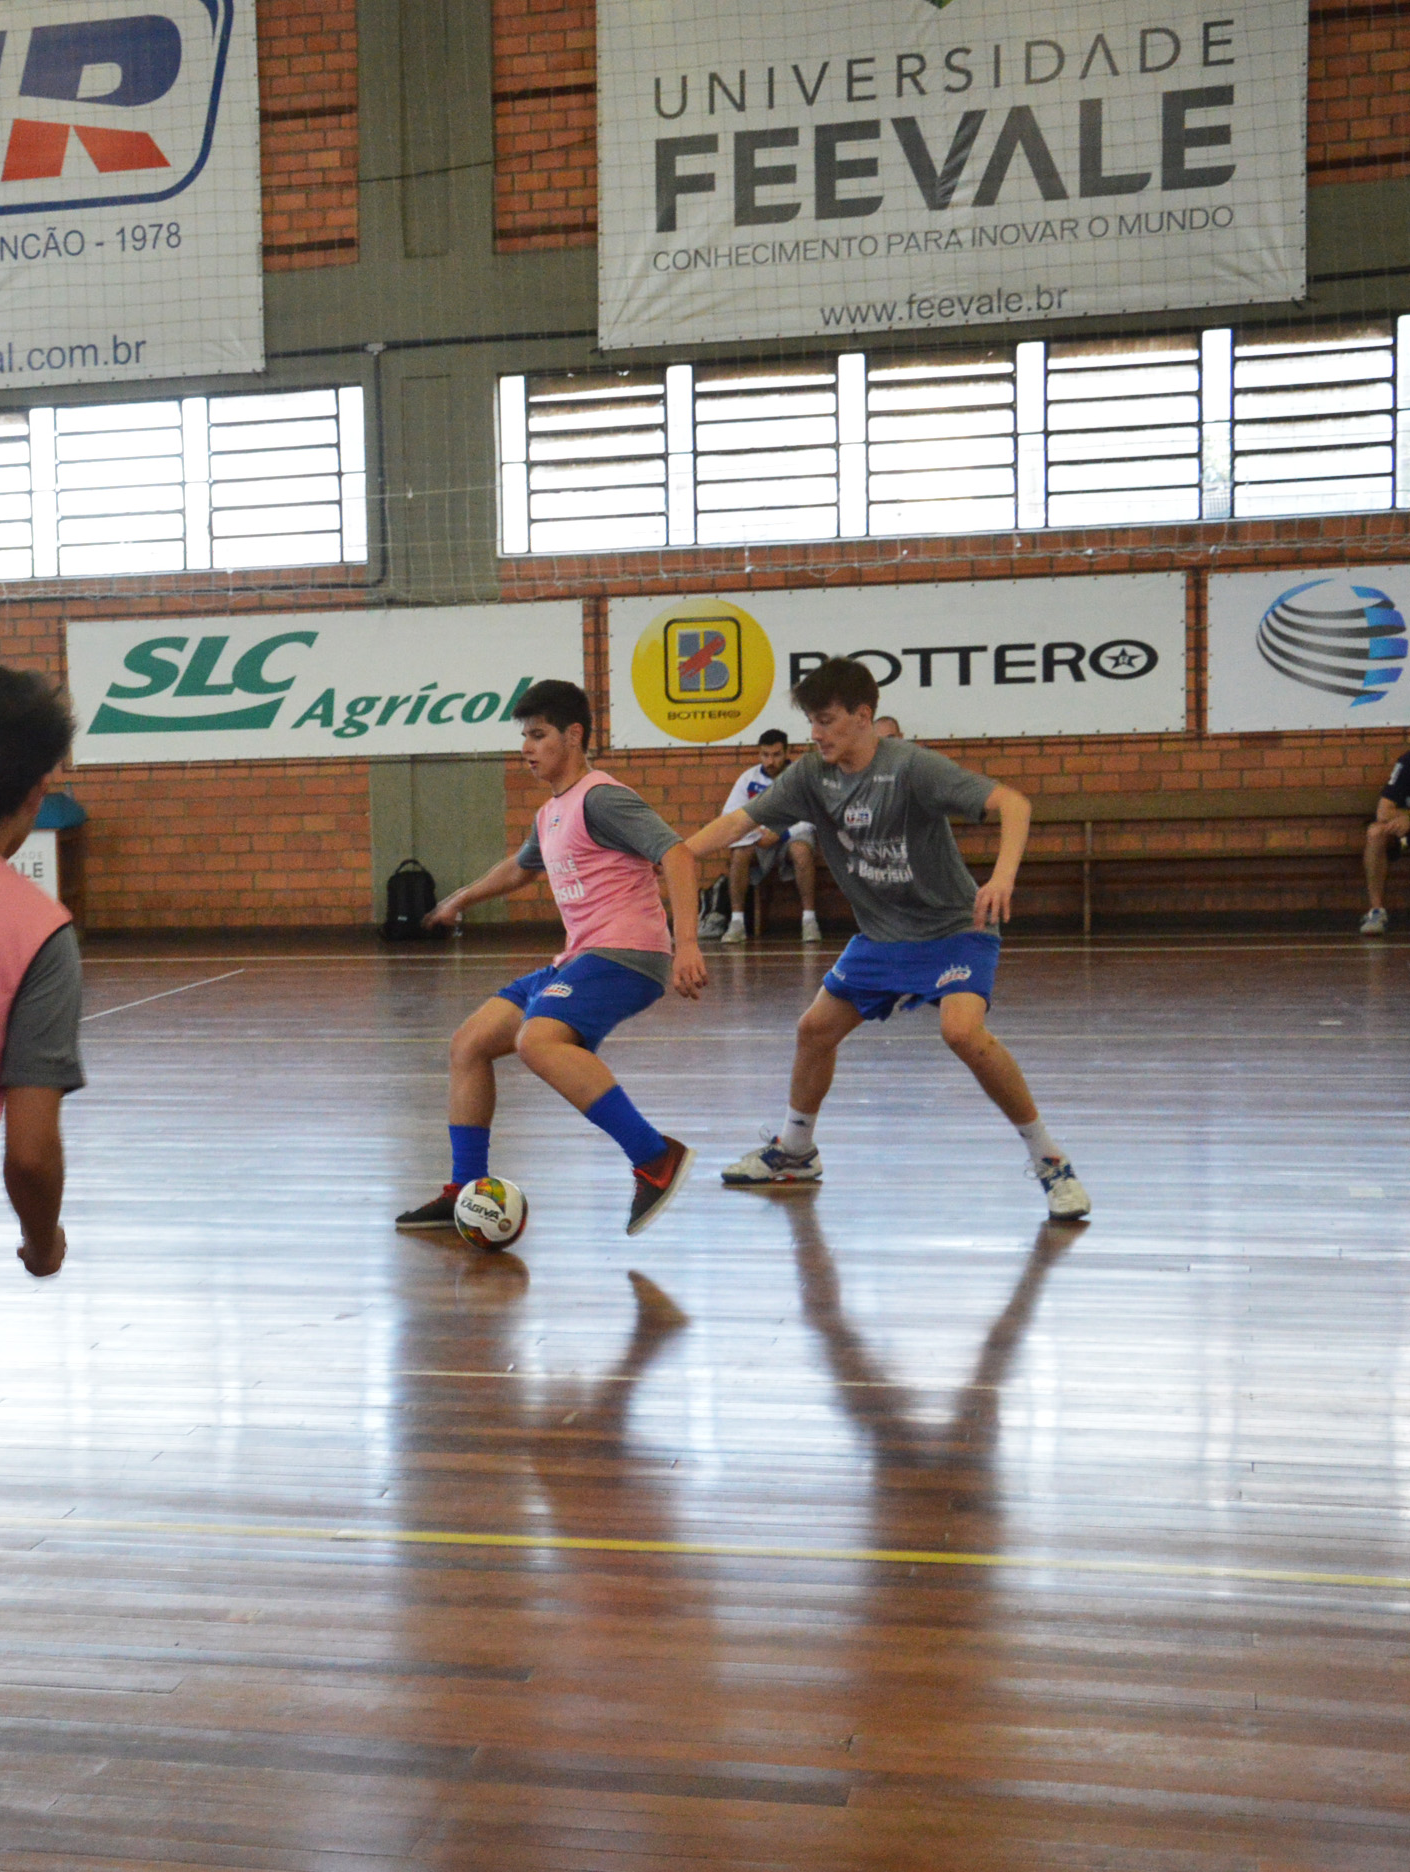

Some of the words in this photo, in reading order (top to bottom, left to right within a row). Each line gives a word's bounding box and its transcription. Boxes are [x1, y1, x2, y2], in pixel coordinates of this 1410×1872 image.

[654, 19, 1235, 119] UNIVERSIDADE
[655, 85, 1237, 233] FEEVALE
[116, 222, 182, 252] 1978
[653, 235, 878, 272] CONHECIMENTO
[887, 228, 963, 255] PARA
[971, 218, 1079, 248] INOVAR
[1088, 215, 1109, 238] O
[1118, 206, 1234, 236] MUNDO
[820, 284, 1069, 326] www.feevale.br
[106, 631, 319, 699] SLC
[291, 677, 534, 739] Agrícol
[667, 710, 741, 720] BOTTERO
